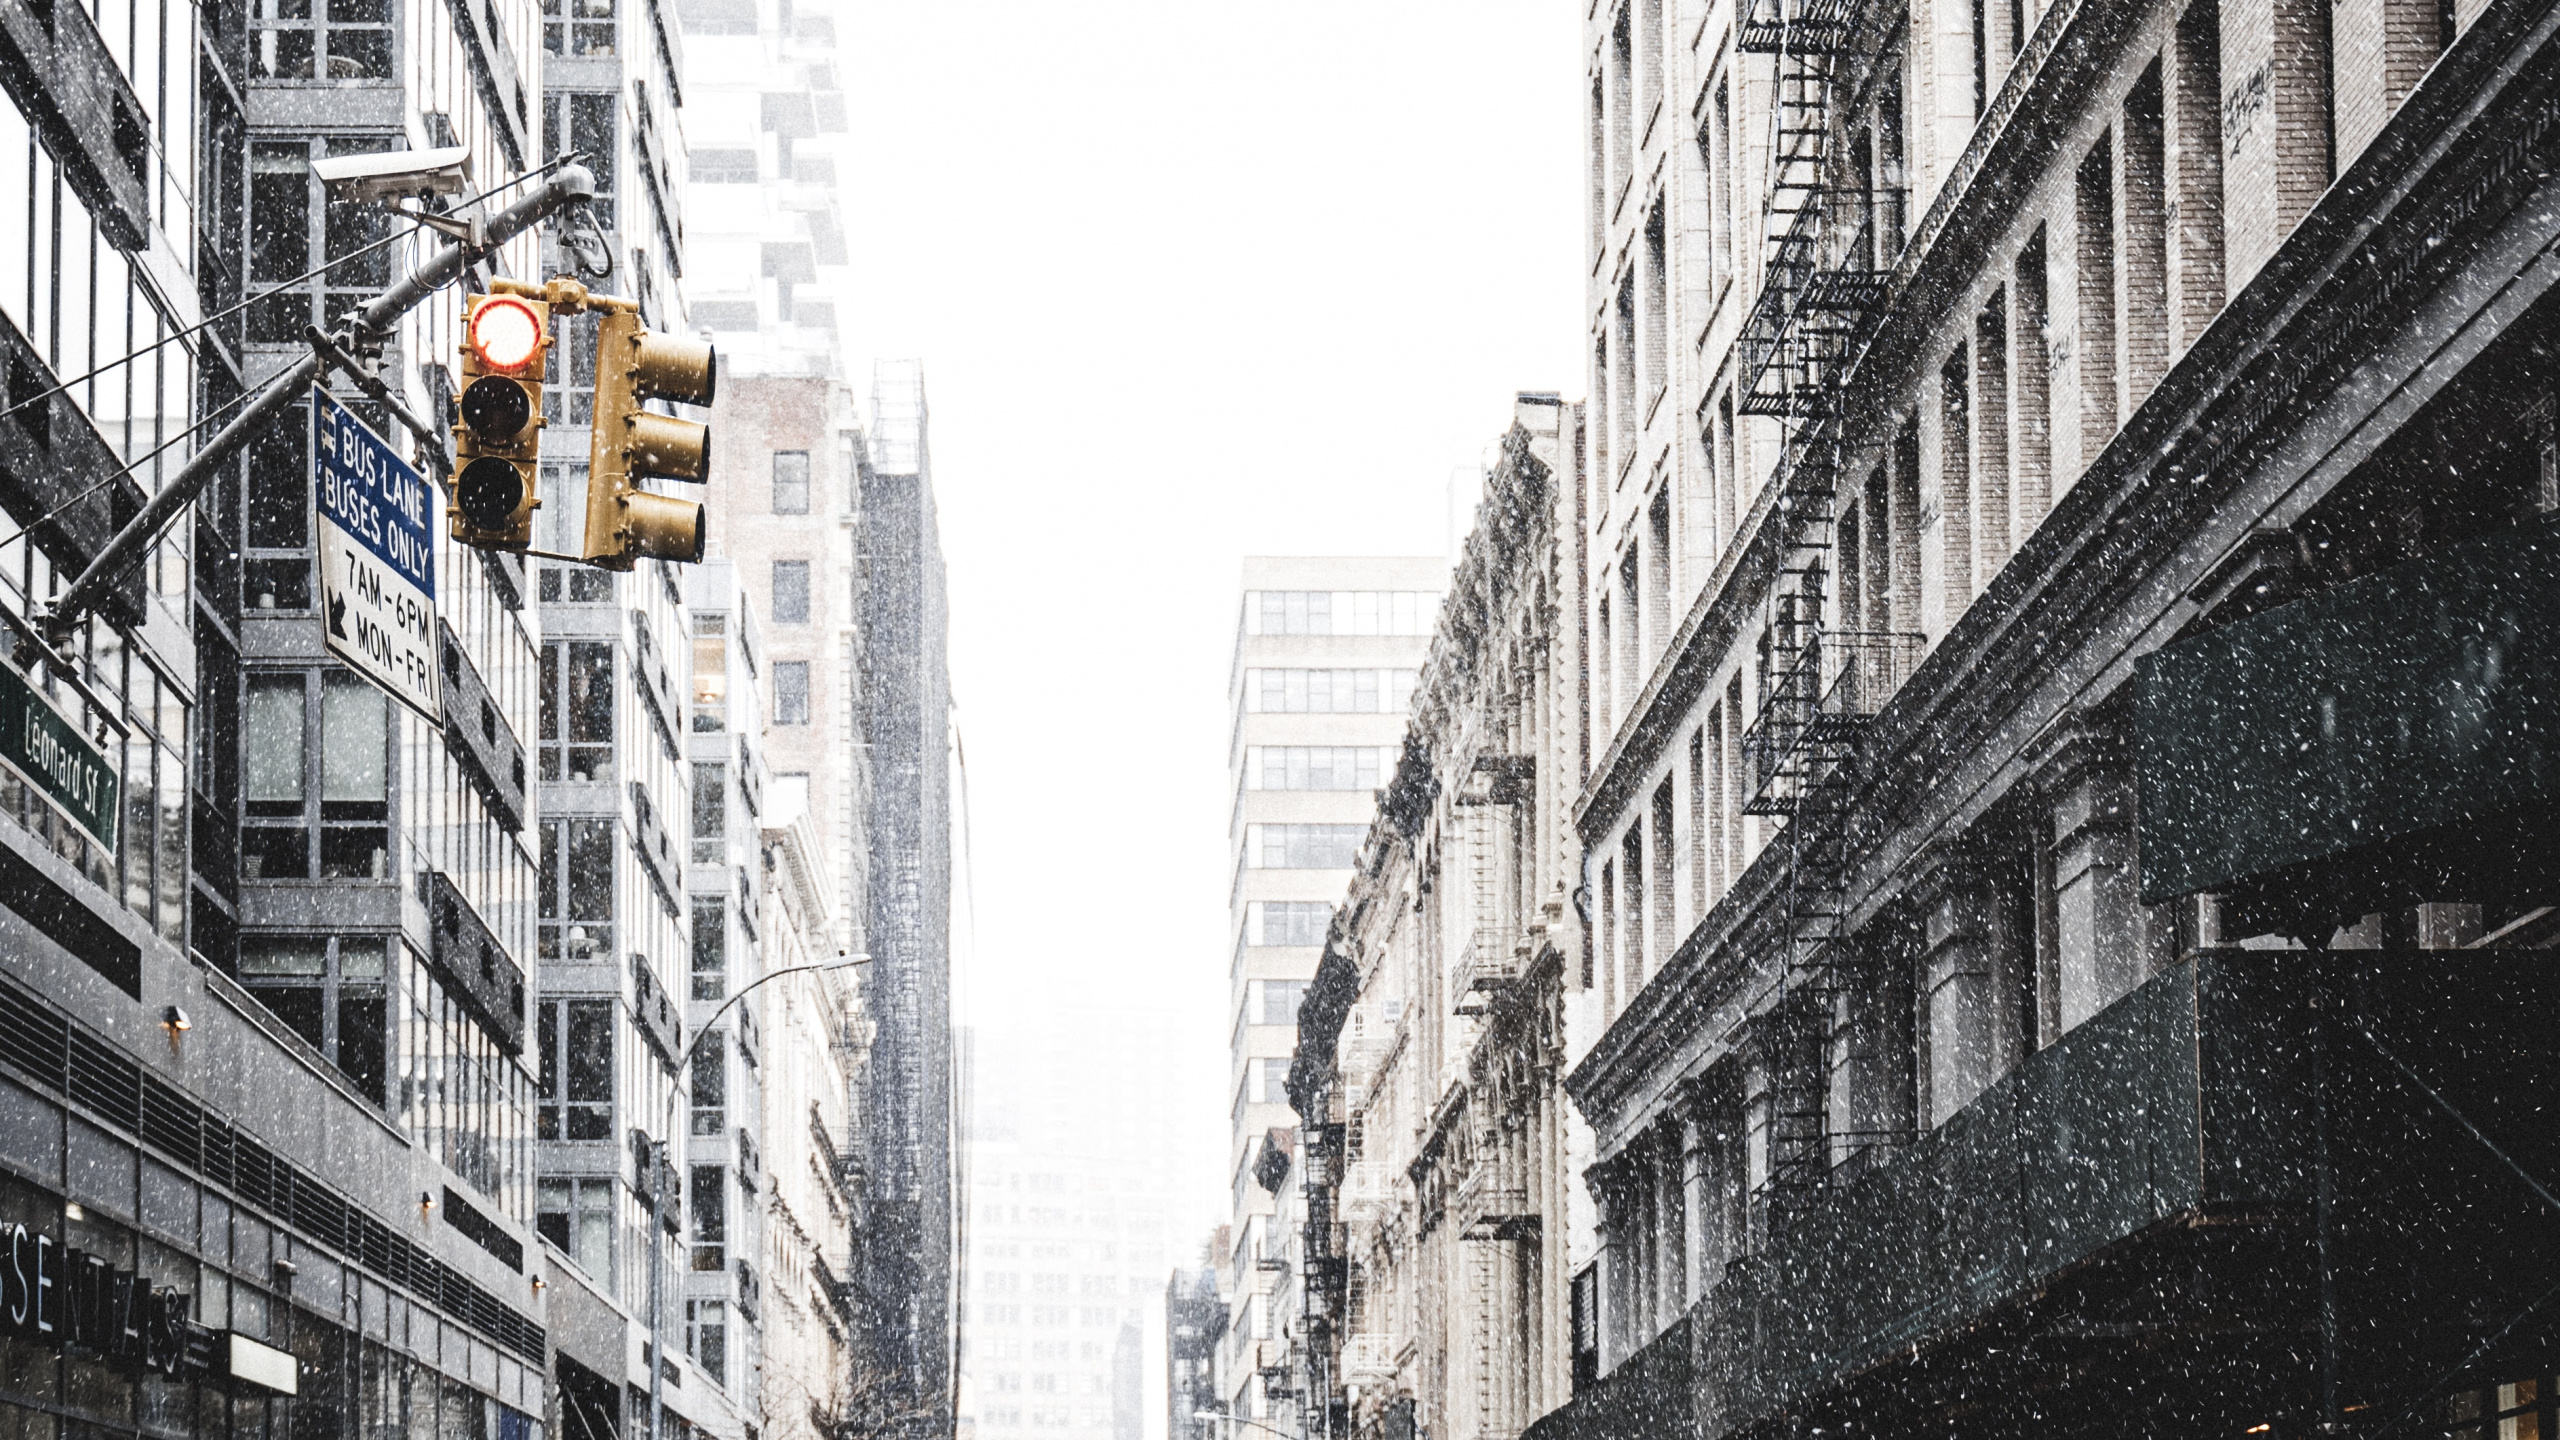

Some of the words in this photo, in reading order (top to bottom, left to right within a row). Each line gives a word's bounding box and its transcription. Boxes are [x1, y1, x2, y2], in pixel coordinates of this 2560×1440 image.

[325, 467, 381, 545] BUSES
[388, 525, 429, 582] ONLY
[343, 426, 376, 487] BUS
[383, 460, 425, 530] LANE
[26, 706, 81, 800] Leonard
[85, 765, 98, 818] St
